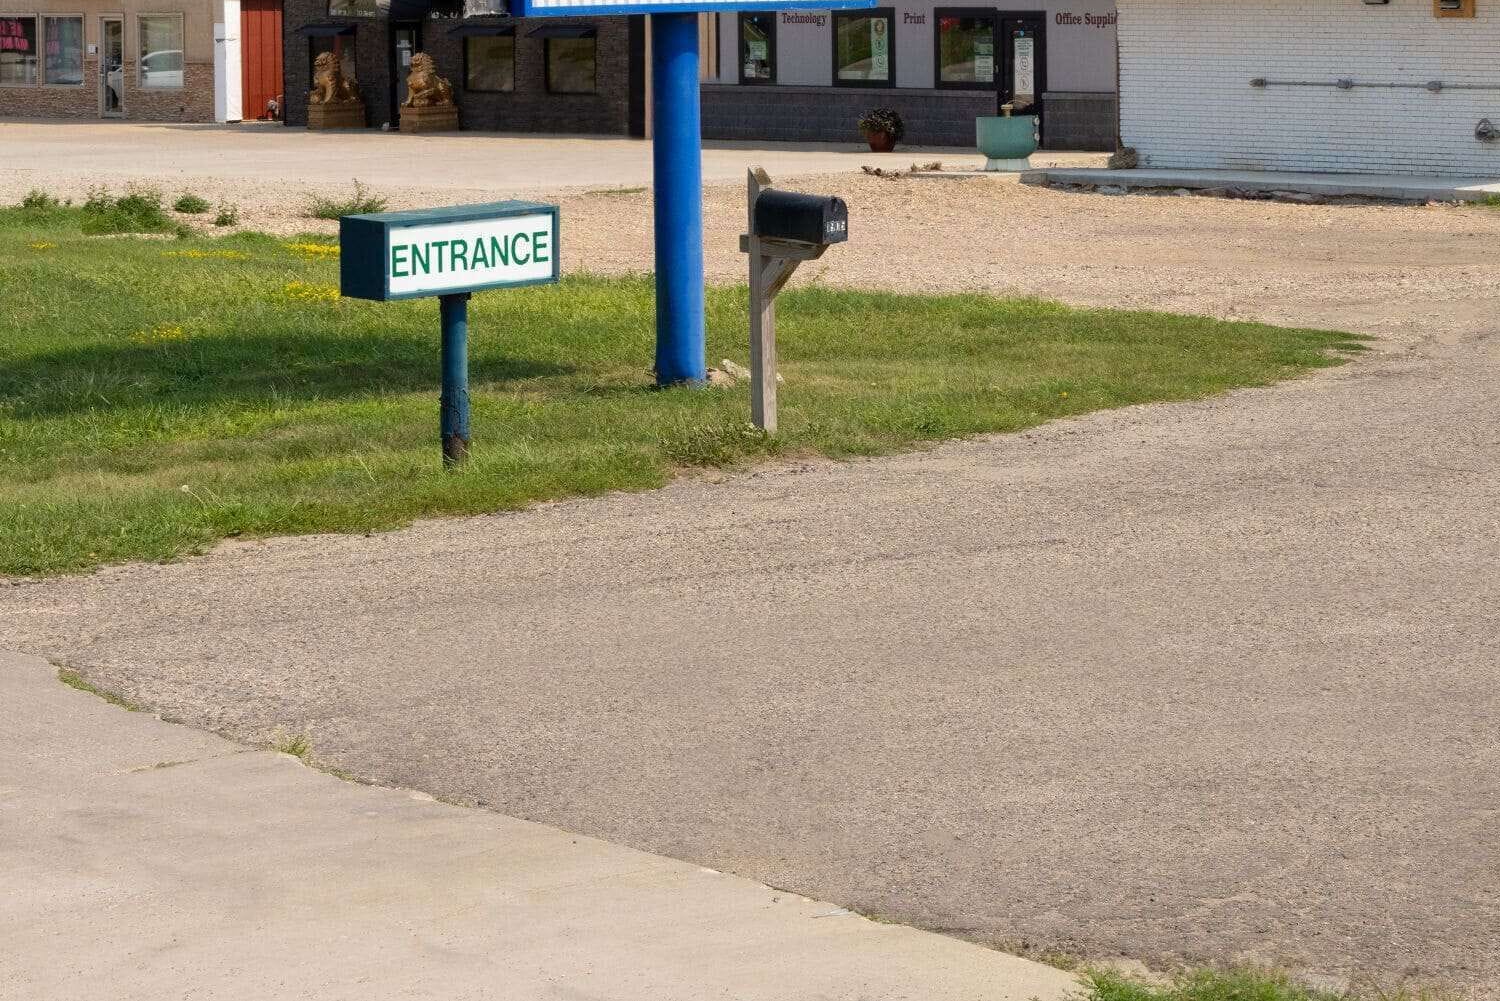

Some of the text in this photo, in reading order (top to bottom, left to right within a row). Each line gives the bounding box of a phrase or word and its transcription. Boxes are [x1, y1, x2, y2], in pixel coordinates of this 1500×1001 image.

[781, 12, 827, 27] Technology
[904, 12, 926, 25] Print
[1055, 12, 1082, 25] Office
[392, 231, 549, 277] ENTRANCE
